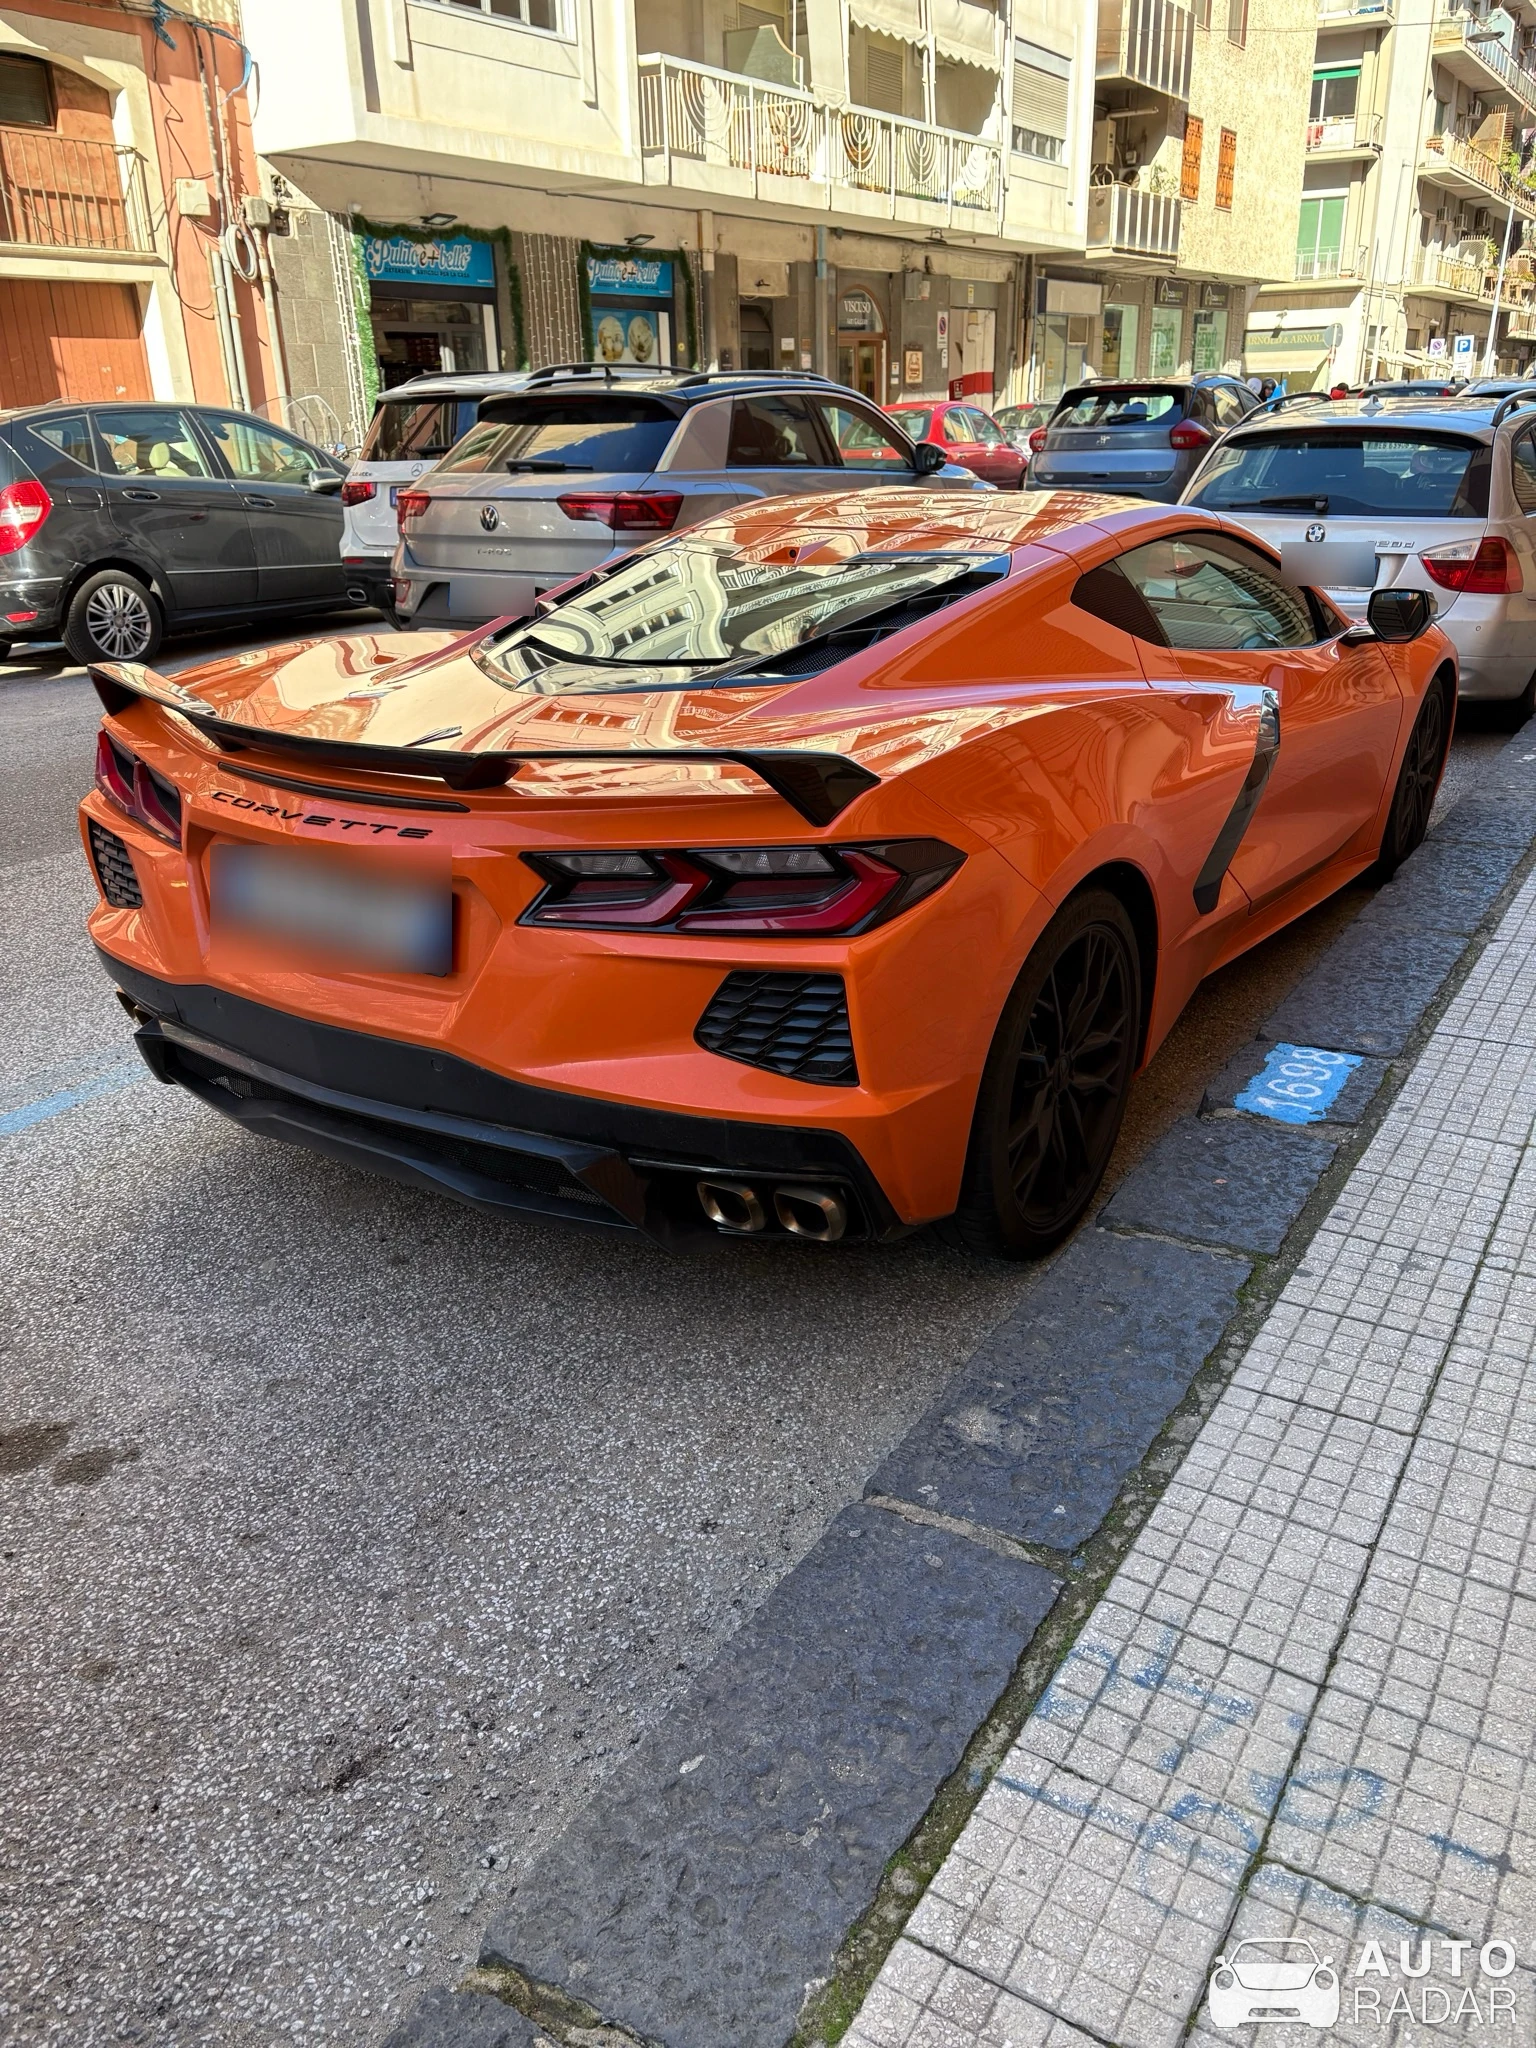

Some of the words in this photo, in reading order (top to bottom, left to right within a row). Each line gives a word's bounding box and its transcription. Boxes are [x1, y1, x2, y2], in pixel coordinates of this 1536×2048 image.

[370, 239, 418, 273] Pulito
[439, 244, 471, 271] bello
[844, 301, 871, 313] VISCUSO
[1247, 335, 1282, 345] ARNOLD
[1290, 333, 1324, 344] ARNOL
[211, 791, 433, 839] CORVETTE
[1256, 1050, 1346, 1111] 1698
